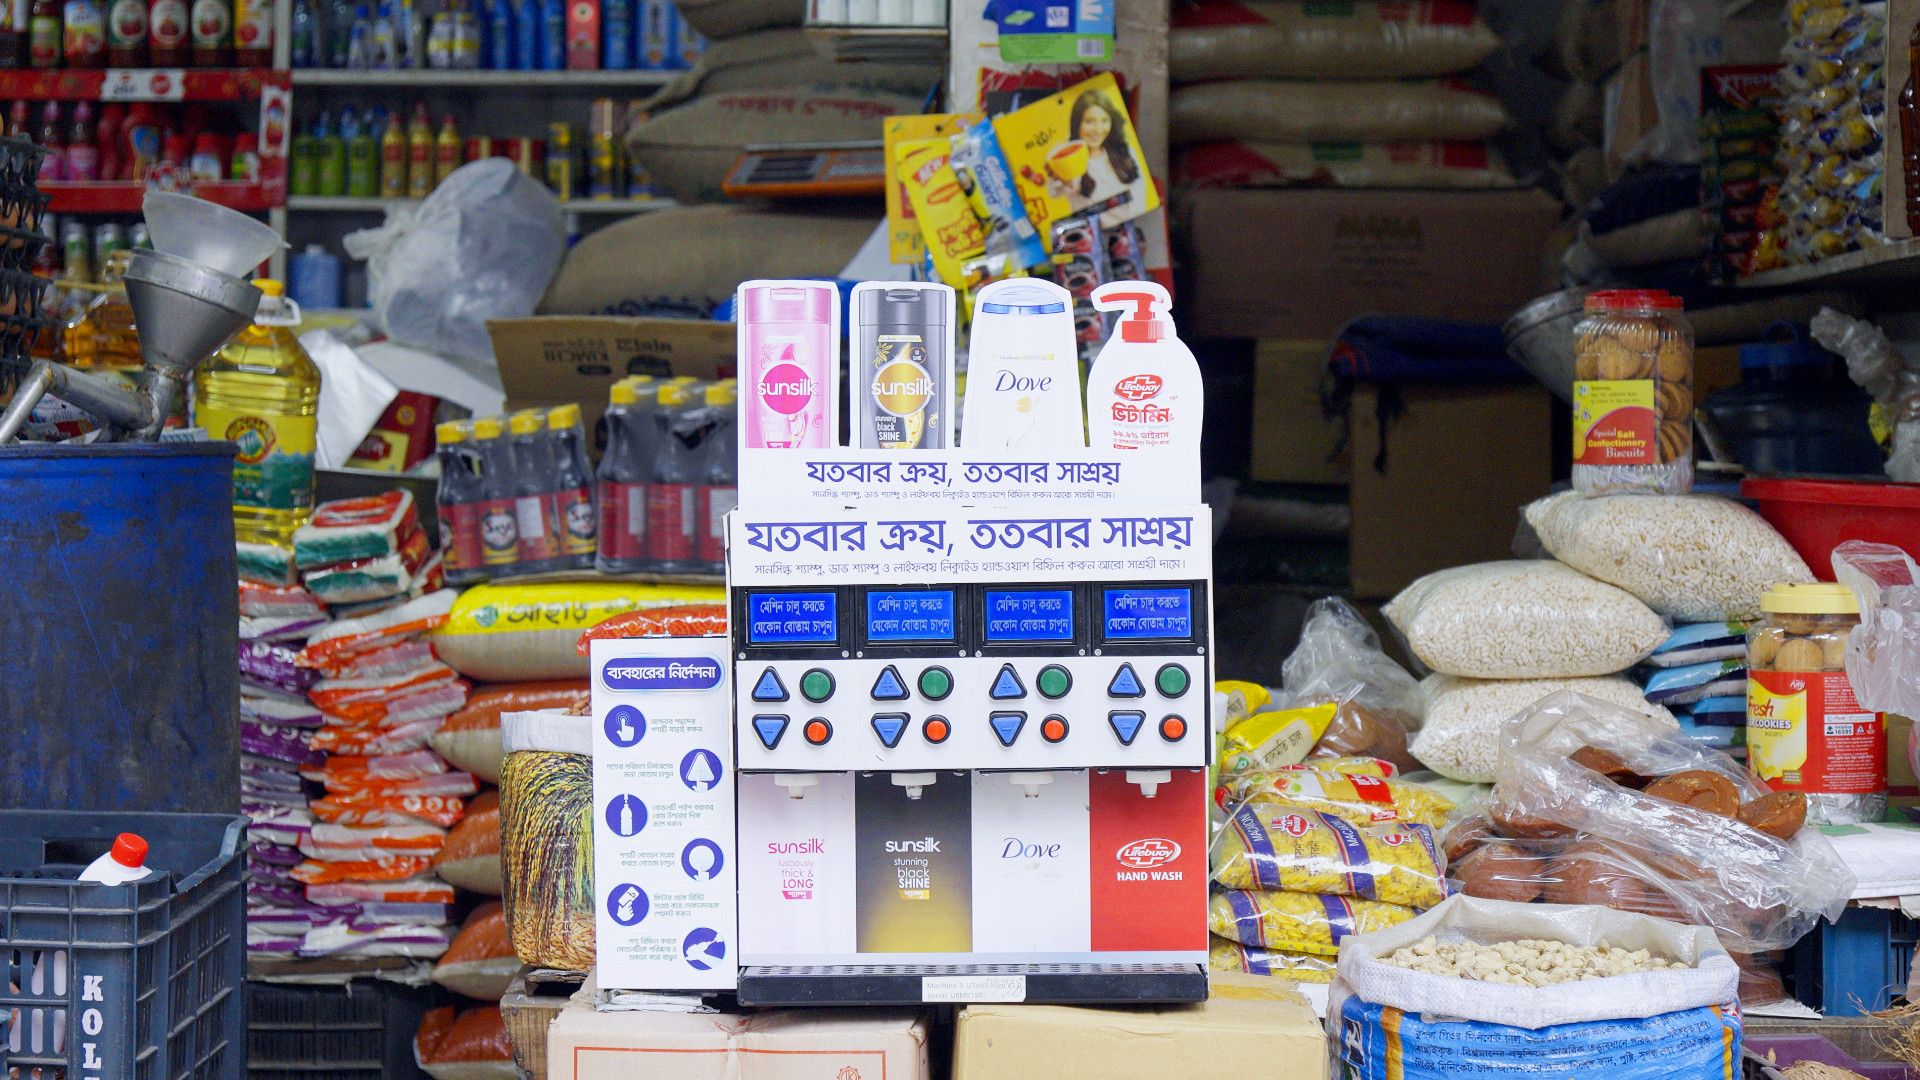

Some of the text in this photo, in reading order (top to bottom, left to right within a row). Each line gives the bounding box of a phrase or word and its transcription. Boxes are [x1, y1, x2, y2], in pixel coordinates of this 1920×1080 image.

[757, 378, 818, 396] sunsilk
[872, 378, 935, 396] sunsilk
[995, 370, 1052, 392] Dove
[1118, 380, 1162, 392] Lifebuoy
[875, 416, 896, 424] stunning
[877, 423, 895, 431] black
[878, 432, 900, 441] SHINE
[1594, 428, 1616, 438] Special
[1588, 440, 1646, 448] Confectionery
[1606, 448, 1645, 457] Biscuits
[806, 462, 1121, 487] যতবার ক্রয়, ততবার সাশ্রয়
[745, 517, 1194, 556] যতবার ক্রয়, ততবার সাশ্রয়
[754, 561, 792, 575] সানসিল্ক
[829, 563, 849, 574] ডাভ
[852, 563, 880, 576] শ্যাম্পু
[882, 564, 890, 573] ও
[893, 560, 937, 573] লাইফবয়
[1033, 558, 1064, 571] রিফিল
[1067, 561, 1095, 572] করুন
[1098, 560, 1124, 570] আরো
[1127, 556, 1156, 570] সাশ্রয়ী
[760, 598, 825, 615] মেশিন চালু করতে
[878, 596, 943, 614] মেশিন চালু করতে
[996, 595, 1062, 614] মেশিন চালু করতে
[1114, 593, 1180, 612] মেশিন চালু করতে
[784, 620, 810, 633] বোতাম
[813, 620, 832, 635] চাপুন
[901, 619, 927, 632] বোতাম
[930, 619, 950, 634] চাপুন
[1019, 619, 1046, 632] বোতাম
[1049, 619, 1069, 634] চাপুন
[1138, 617, 1164, 630] বোতাম
[1167, 617, 1187, 632] চাপুন
[607, 662, 716, 679] ব্যবহারের নির্দেশনা
[1755, 720, 1792, 729] COOKIES
[768, 838, 824, 854] sunsilk
[885, 837, 941, 853] sunsilk
[1001, 837, 1061, 859] Dove
[1124, 848, 1175, 858] Lifebuoy
[778, 860, 814, 868] lusciously
[894, 858, 928, 867] stunning
[781, 869, 804, 878] thick
[898, 867, 929, 878] black
[1117, 871, 1183, 881] HAND WASH
[783, 879, 814, 889] LONG
[898, 878, 930, 888] SHINE
[82, 975, 103, 1080] KOL
